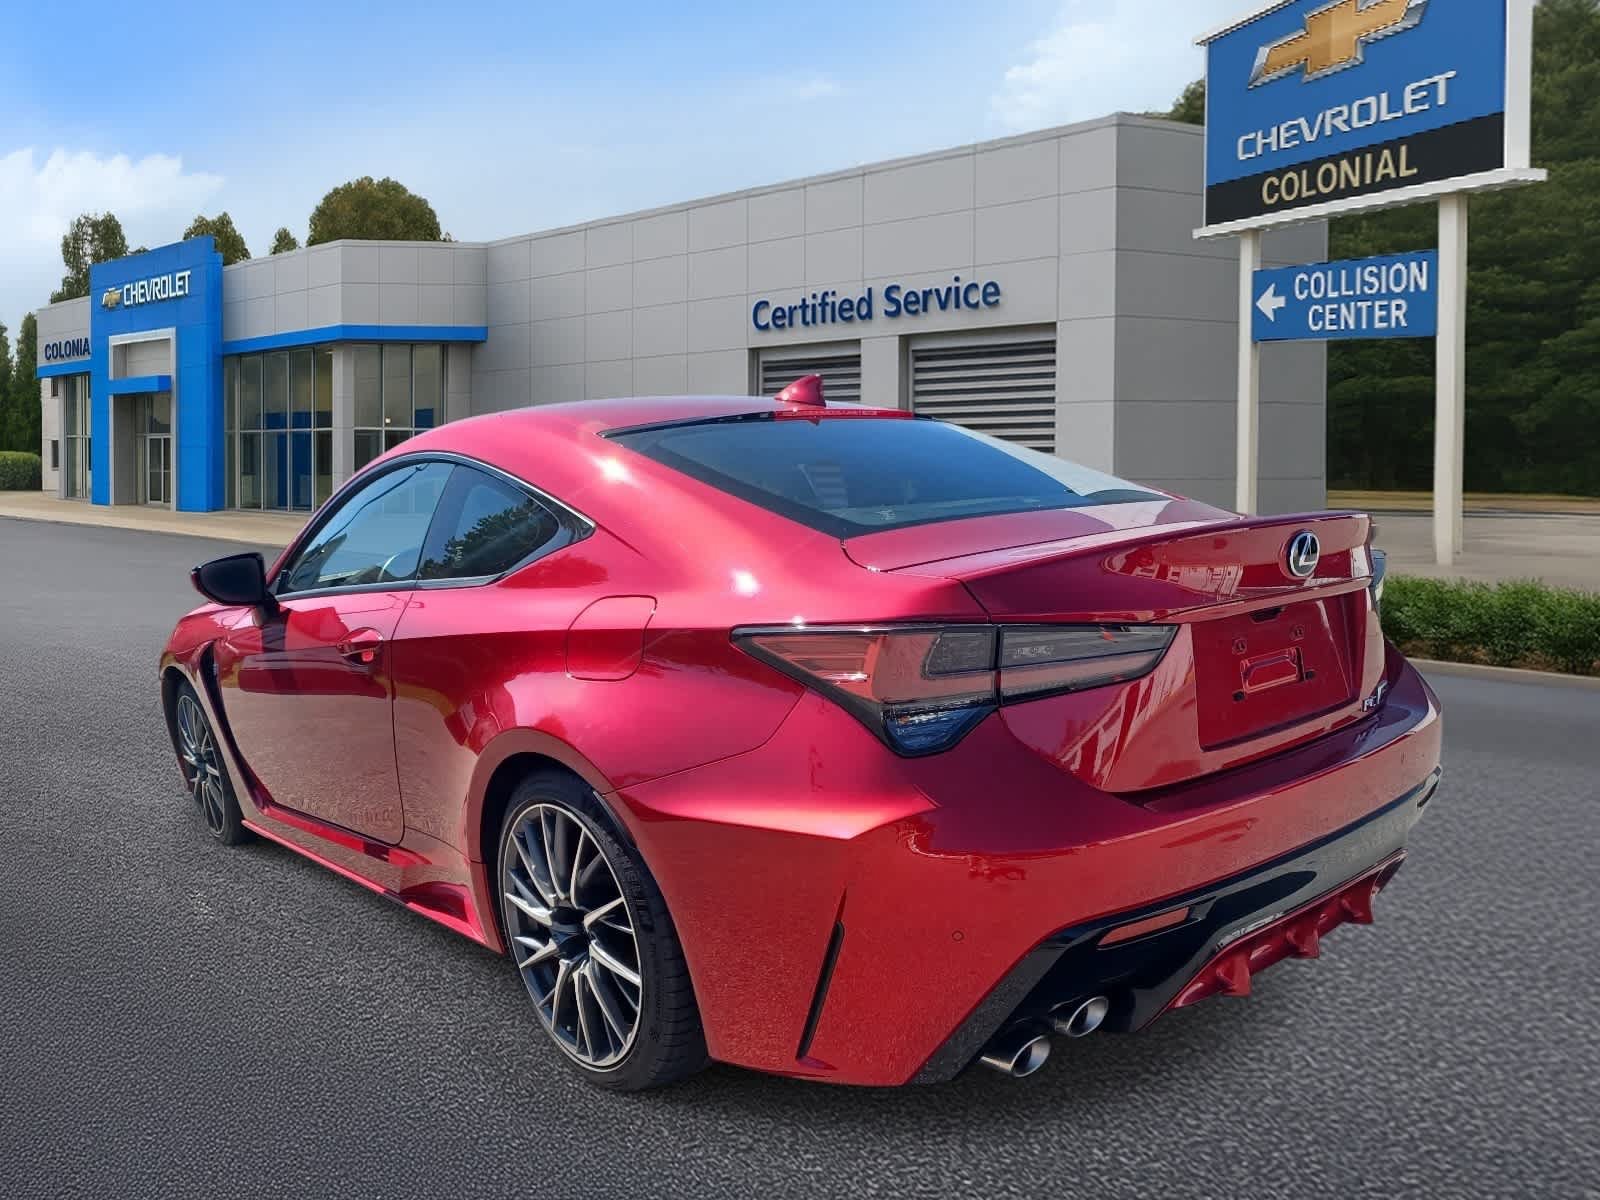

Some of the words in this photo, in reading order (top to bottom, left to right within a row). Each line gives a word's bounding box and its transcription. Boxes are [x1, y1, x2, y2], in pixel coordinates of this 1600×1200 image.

[1236, 70, 1457, 161] CHEVROLET
[1261, 144, 1418, 205] COLONIAL
[123, 270, 191, 306] CHEVROLET
[752, 286, 873, 331] Certified
[884, 276, 1001, 318] Service
[1294, 260, 1429, 300] COLLISION
[1307, 298, 1408, 332] CENTER
